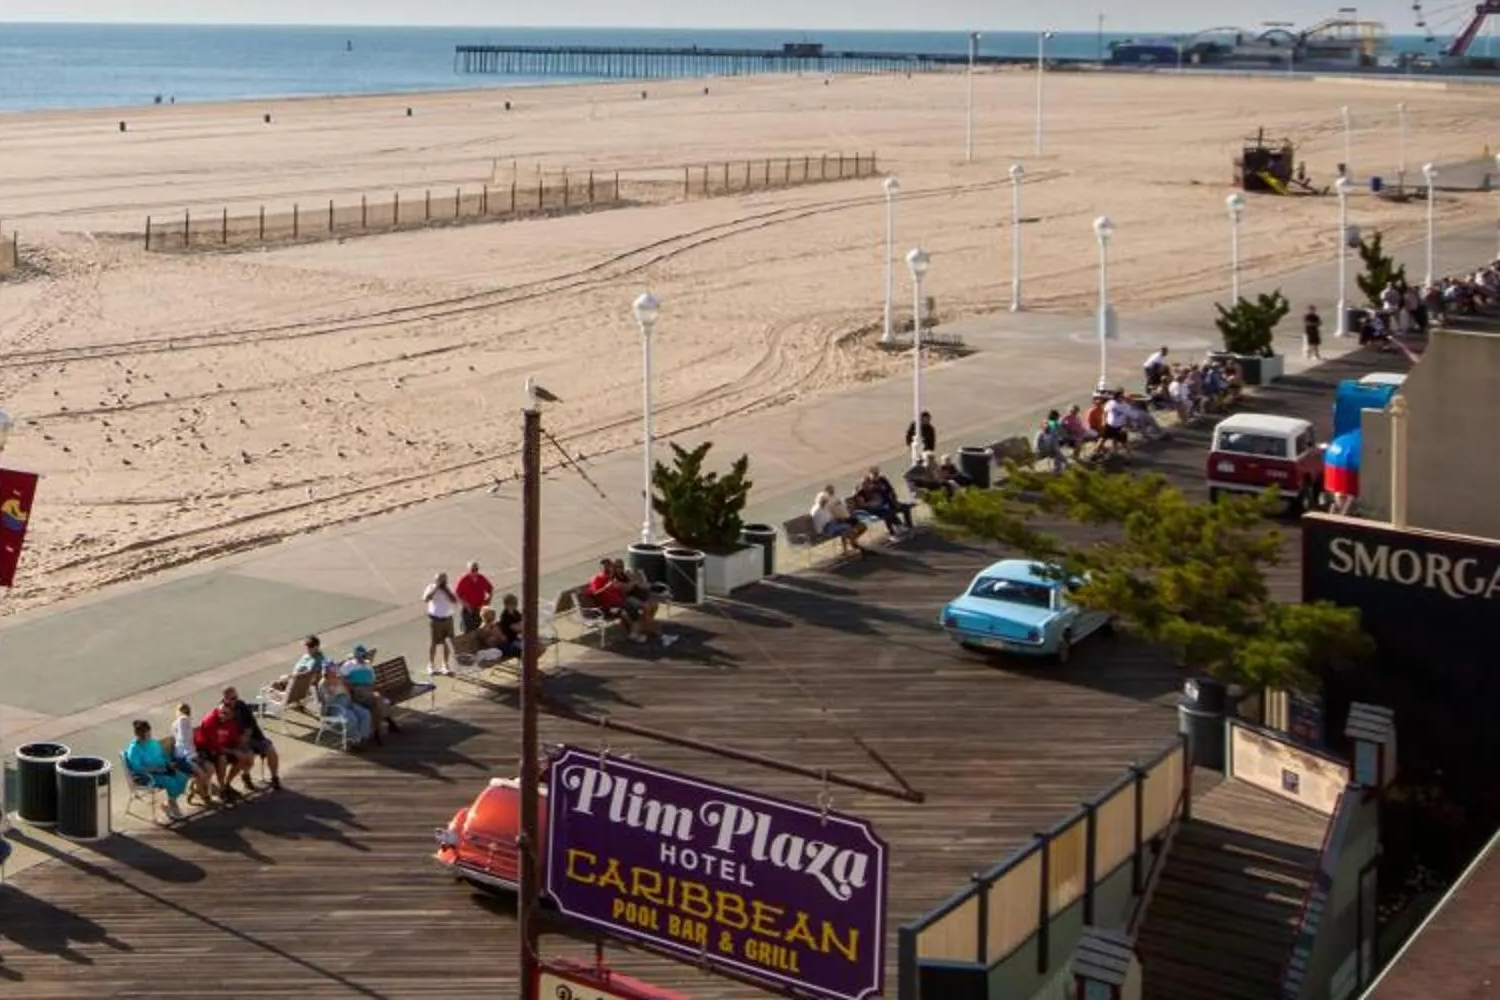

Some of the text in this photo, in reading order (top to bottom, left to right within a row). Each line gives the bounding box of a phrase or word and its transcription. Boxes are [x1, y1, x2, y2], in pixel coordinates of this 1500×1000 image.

[562, 764, 869, 901] Plim Plaza
[659, 843, 754, 887] HOTEL
[565, 849, 860, 961] CARIBBEAN
[612, 898, 800, 973] POOL BAR & GRILL
